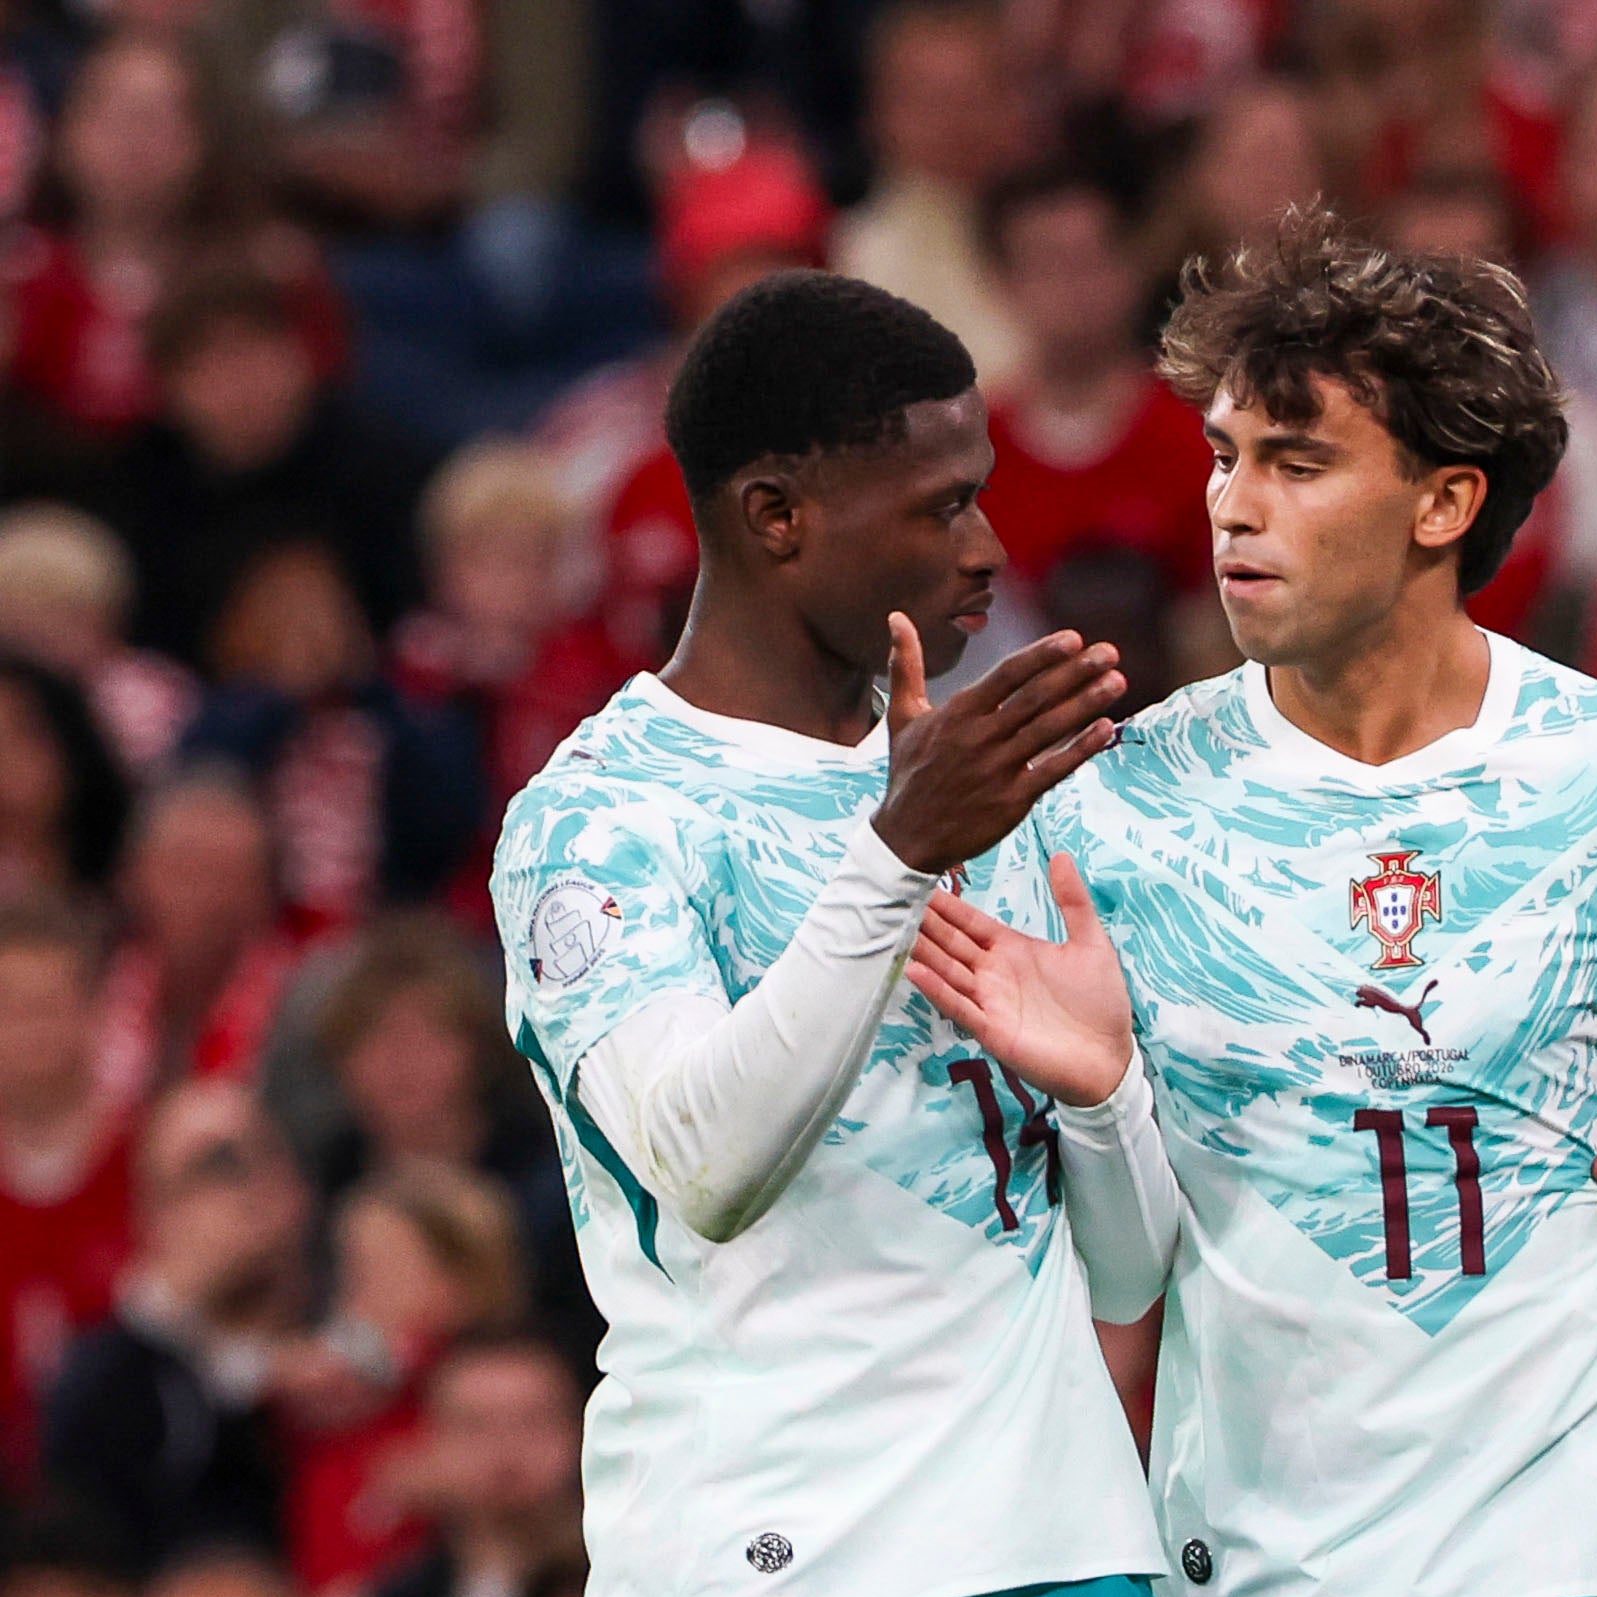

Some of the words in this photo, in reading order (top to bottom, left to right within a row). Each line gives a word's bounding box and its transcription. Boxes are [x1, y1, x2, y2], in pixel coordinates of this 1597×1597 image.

[1364, 1061, 1421, 1079] OUTUBRO
[1424, 1060, 1455, 1074] 2026
[1353, 1105, 1487, 1281] 11
